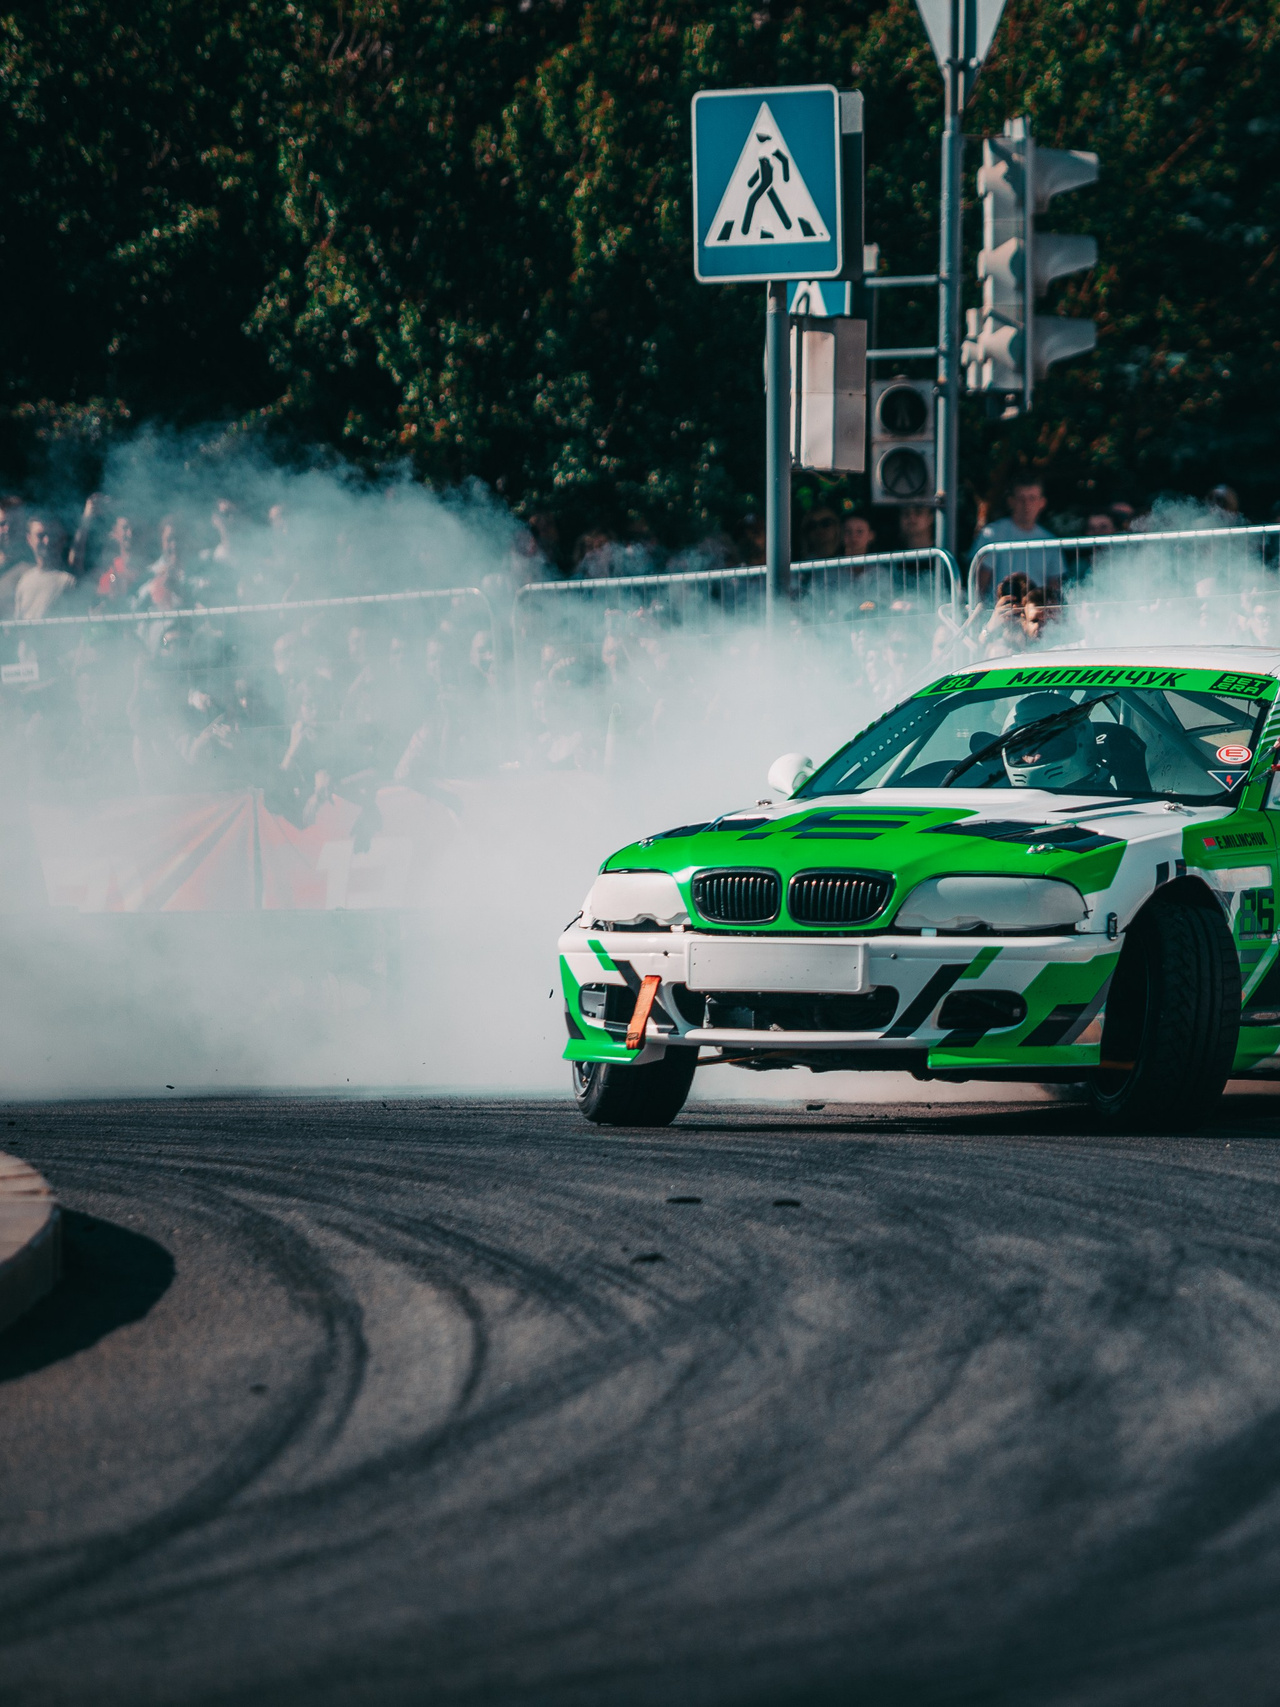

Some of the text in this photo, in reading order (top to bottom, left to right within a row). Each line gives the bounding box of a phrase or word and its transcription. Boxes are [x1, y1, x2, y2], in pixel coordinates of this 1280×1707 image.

[941, 676, 972, 690] 86
[1006, 669, 1188, 687] МИЛИНЧУК
[1222, 675, 1266, 687] BET
[1215, 831, 1268, 849] E.MILINCHUK
[1239, 888, 1275, 940] 86
